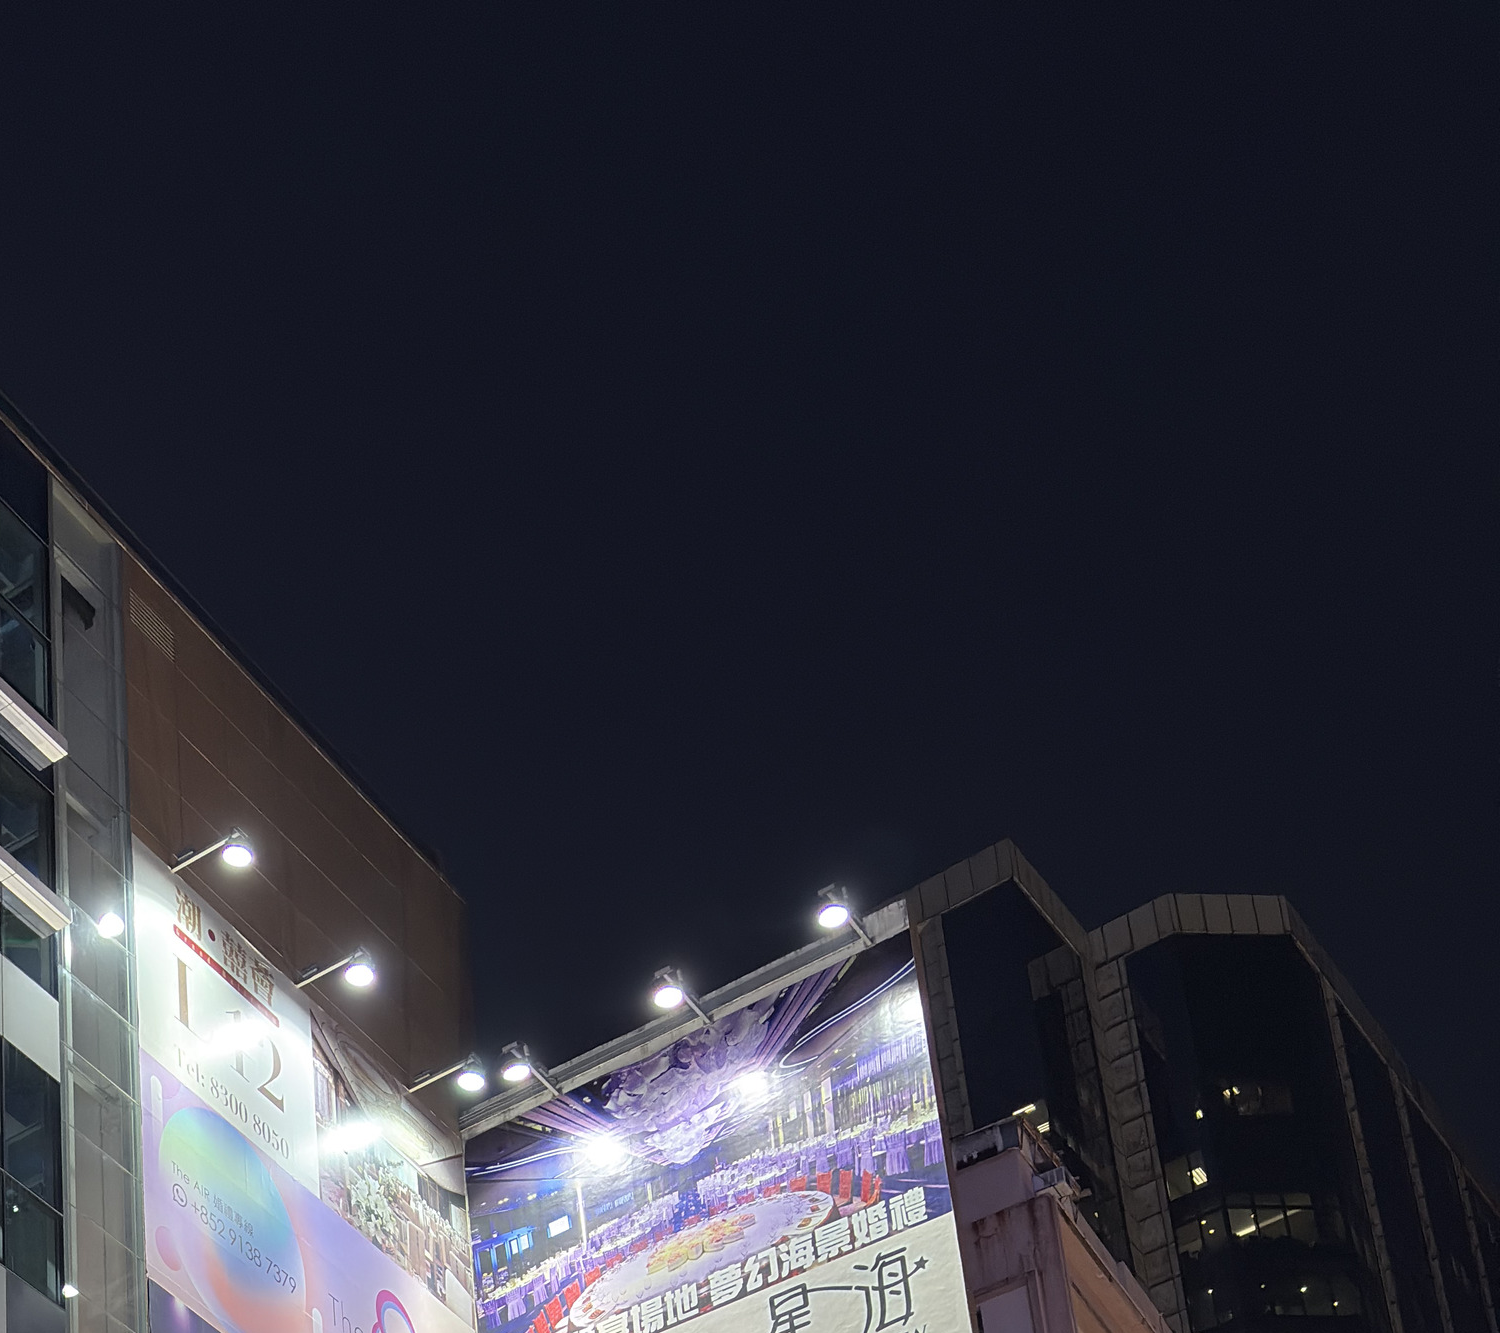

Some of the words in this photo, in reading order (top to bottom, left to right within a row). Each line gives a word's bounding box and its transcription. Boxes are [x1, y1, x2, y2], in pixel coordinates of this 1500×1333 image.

[211, 1076, 248, 1124] 8300
[253, 1113, 290, 1160] 8050
[172, 1161, 191, 1185] The
[193, 1180, 211, 1201] AIR
[191, 1201, 226, 1240] +852
[228, 1228, 263, 1268] 9138
[265, 1256, 297, 1294] 7379
[708, 1186, 929, 1305] 夢幻海景婚禮
